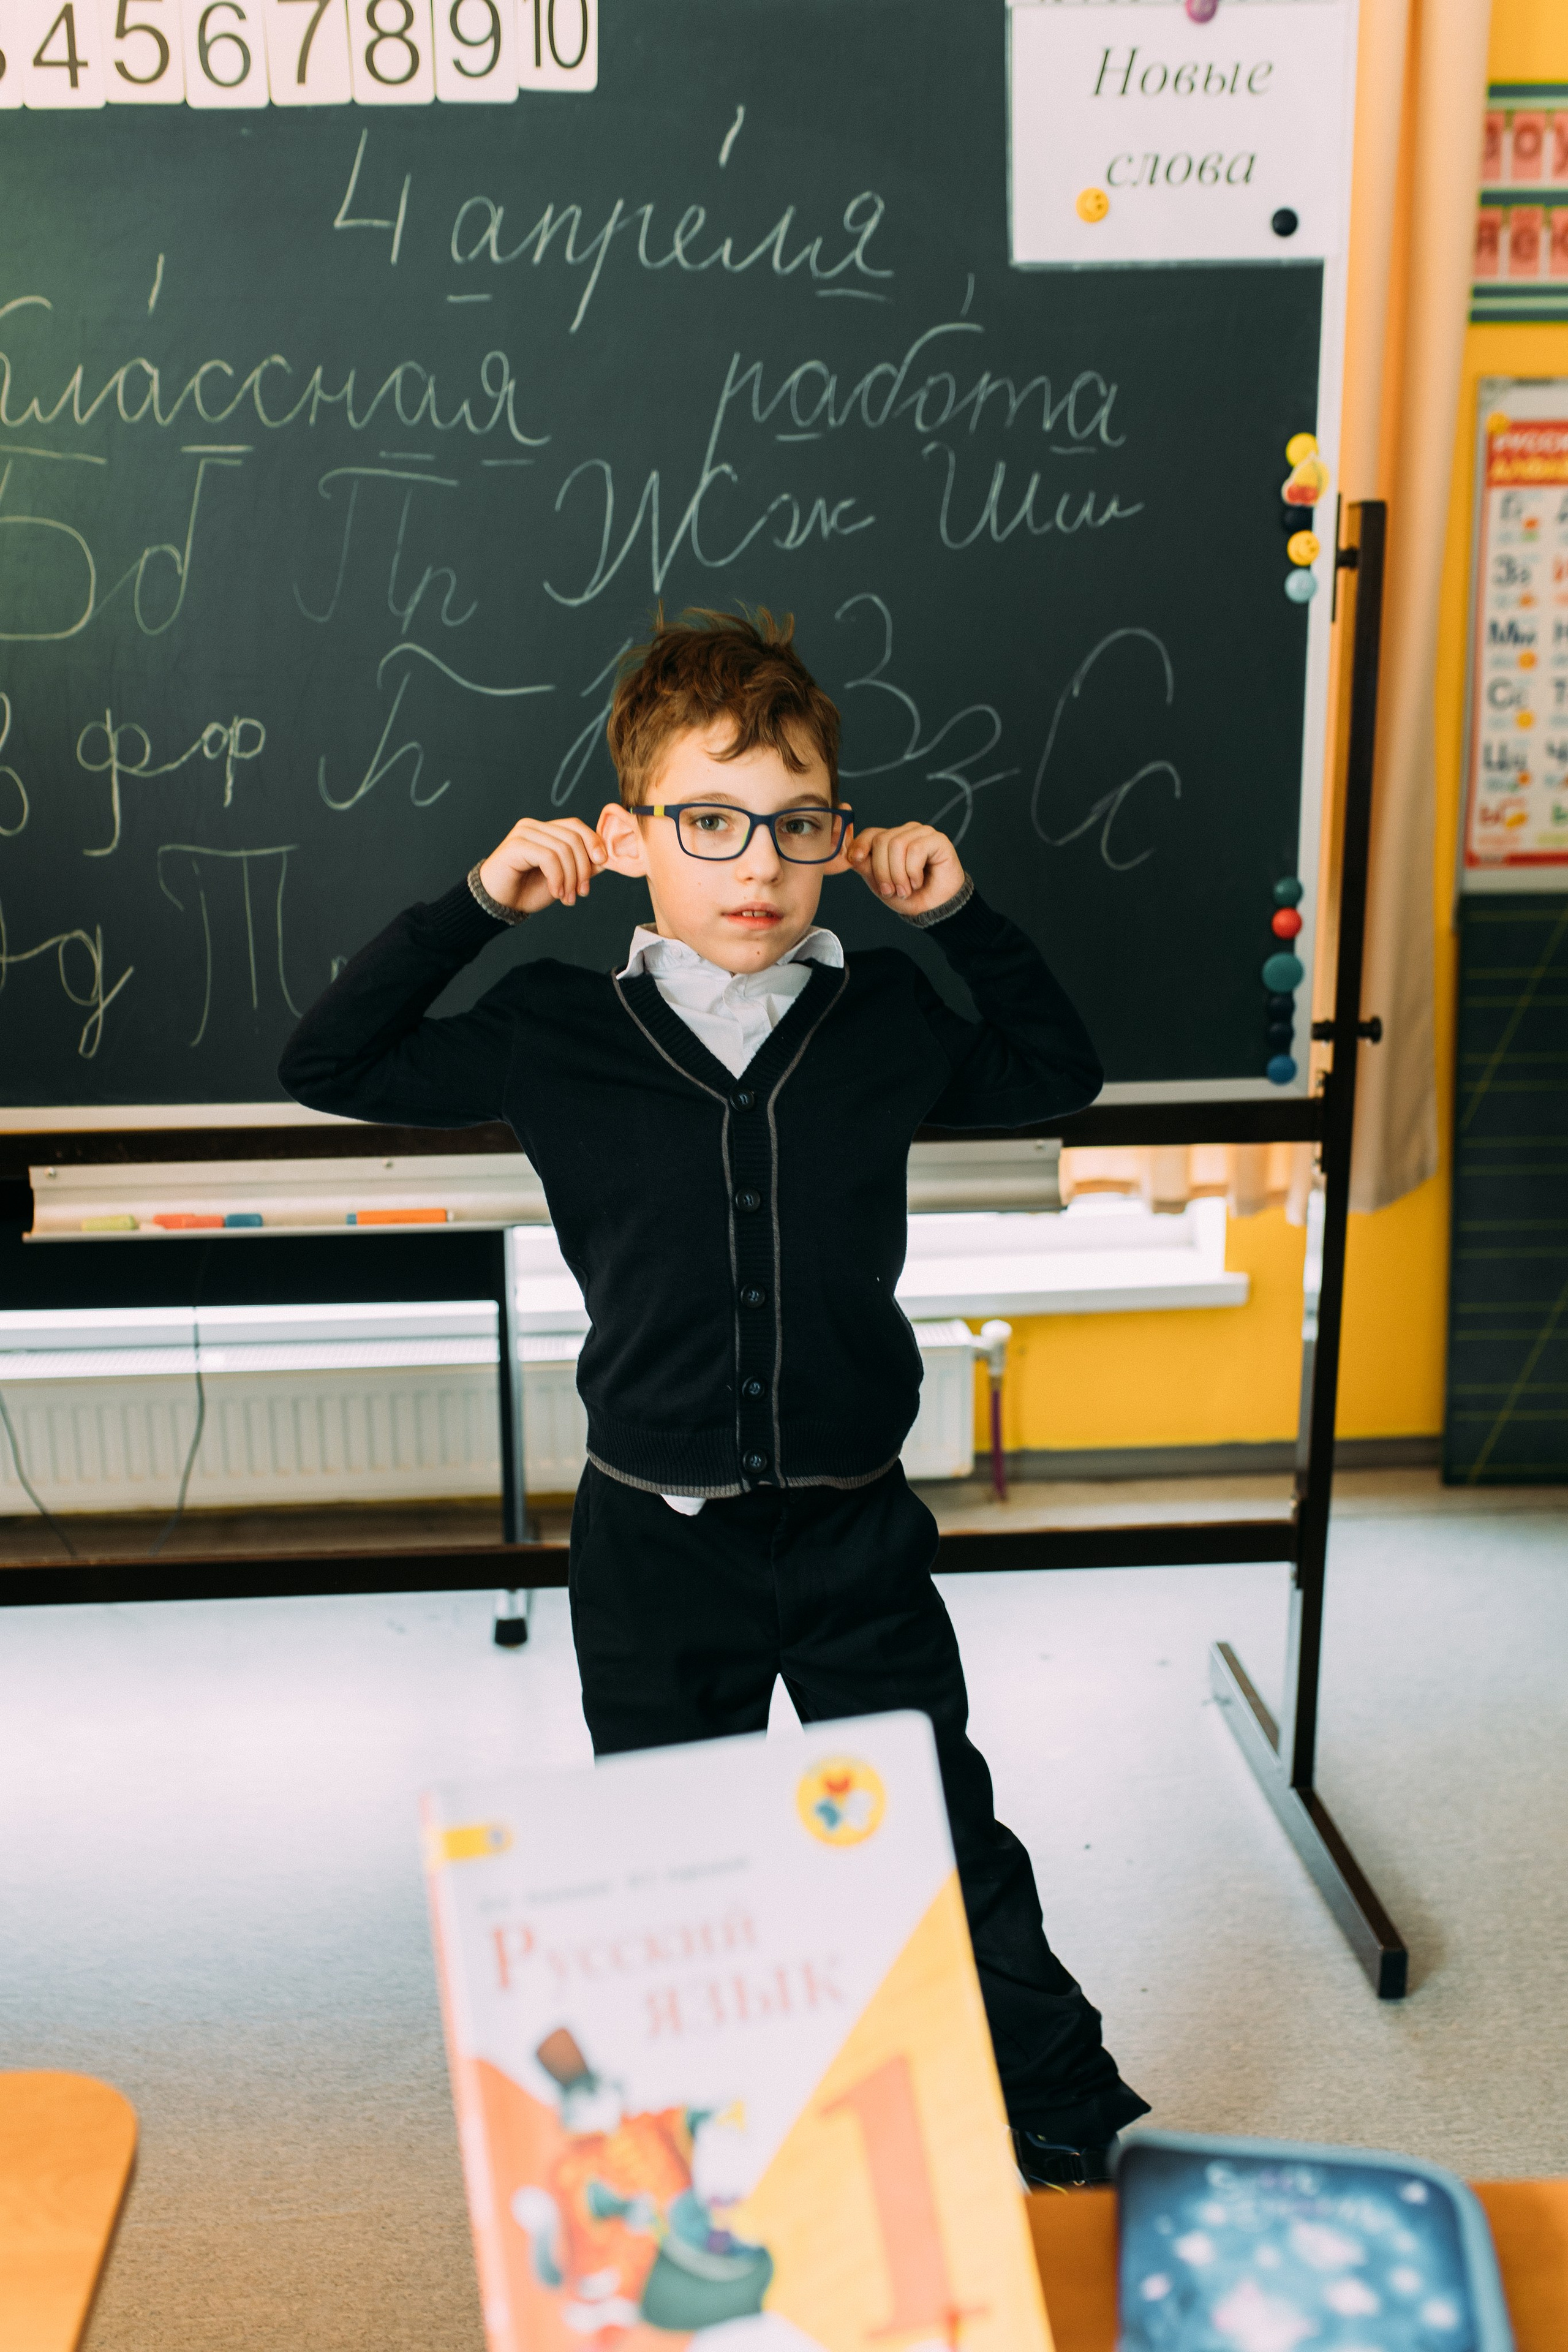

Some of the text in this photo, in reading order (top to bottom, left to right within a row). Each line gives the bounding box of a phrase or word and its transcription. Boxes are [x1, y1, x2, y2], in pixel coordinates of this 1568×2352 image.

[32, 0, 589, 89] 4 5 6 7 8 9 10
[1093, 46, 1274, 96] Новые
[334, 127, 411, 265] 4
[1106, 151, 1256, 187] слова
